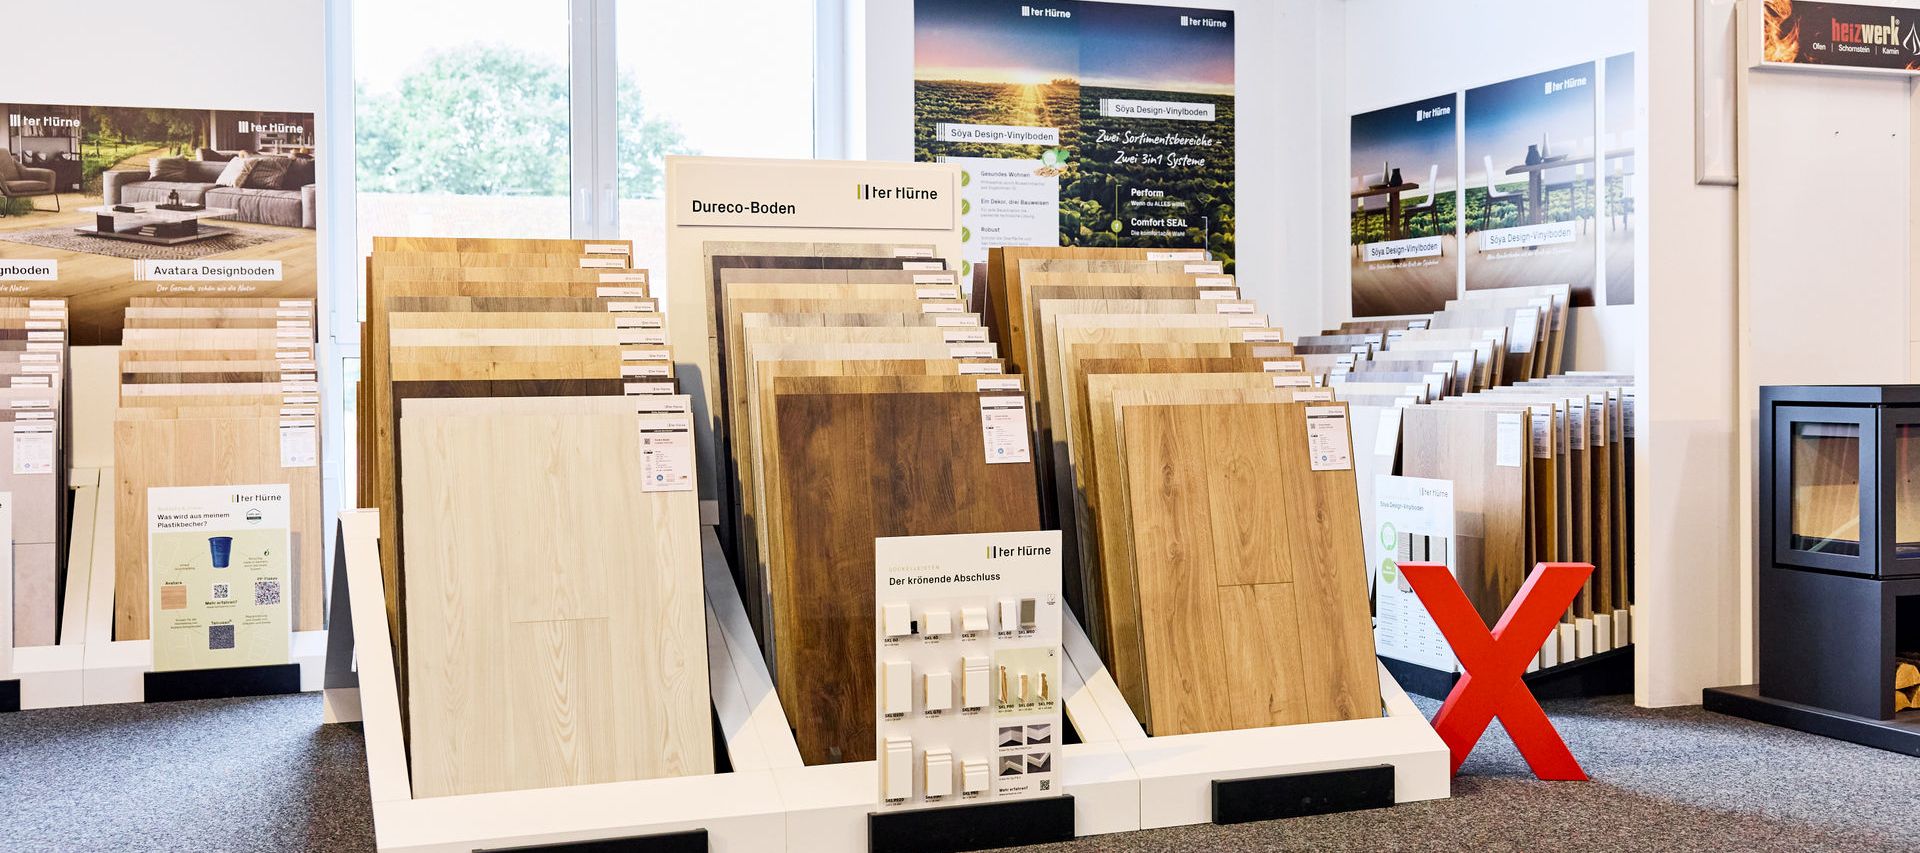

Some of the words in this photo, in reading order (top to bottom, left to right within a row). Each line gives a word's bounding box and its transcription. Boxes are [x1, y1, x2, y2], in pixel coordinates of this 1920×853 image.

[1031, 7, 1044, 17] ter
[1189, 17, 1201, 26] ter
[1812, 42, 1826, 51] Ofen
[1838, 44, 1870, 54] Schornstein
[1882, 47, 1900, 55] Kamin
[1136, 105, 1208, 116] Design-Vinylboden
[23, 116, 41, 126] ter
[250, 122, 268, 133] ter
[974, 129, 1054, 141] Design-Vinylboden
[1096, 129, 1121, 143] Zwei
[1121, 130, 1213, 146] Sortimentsbereiche
[1114, 150, 1139, 164] Zwei
[1141, 153, 1163, 165] 3in1
[1166, 152, 1206, 169] Systeme
[872, 186, 893, 199] ter
[1130, 188, 1164, 198] Perform
[692, 199, 796, 215] Dureco-Boden
[1130, 218, 1165, 227] Comfort
[1166, 219, 1188, 228] SEAL
[154, 266, 199, 276] Avatara
[201, 266, 275, 277] Designboden
[157, 521, 208, 529] Plastikbecher?
[998, 547, 1015, 557] ter
[889, 577, 906, 586] Der
[907, 574, 952, 585] krönende
[953, 572, 1001, 583] Abschluss
